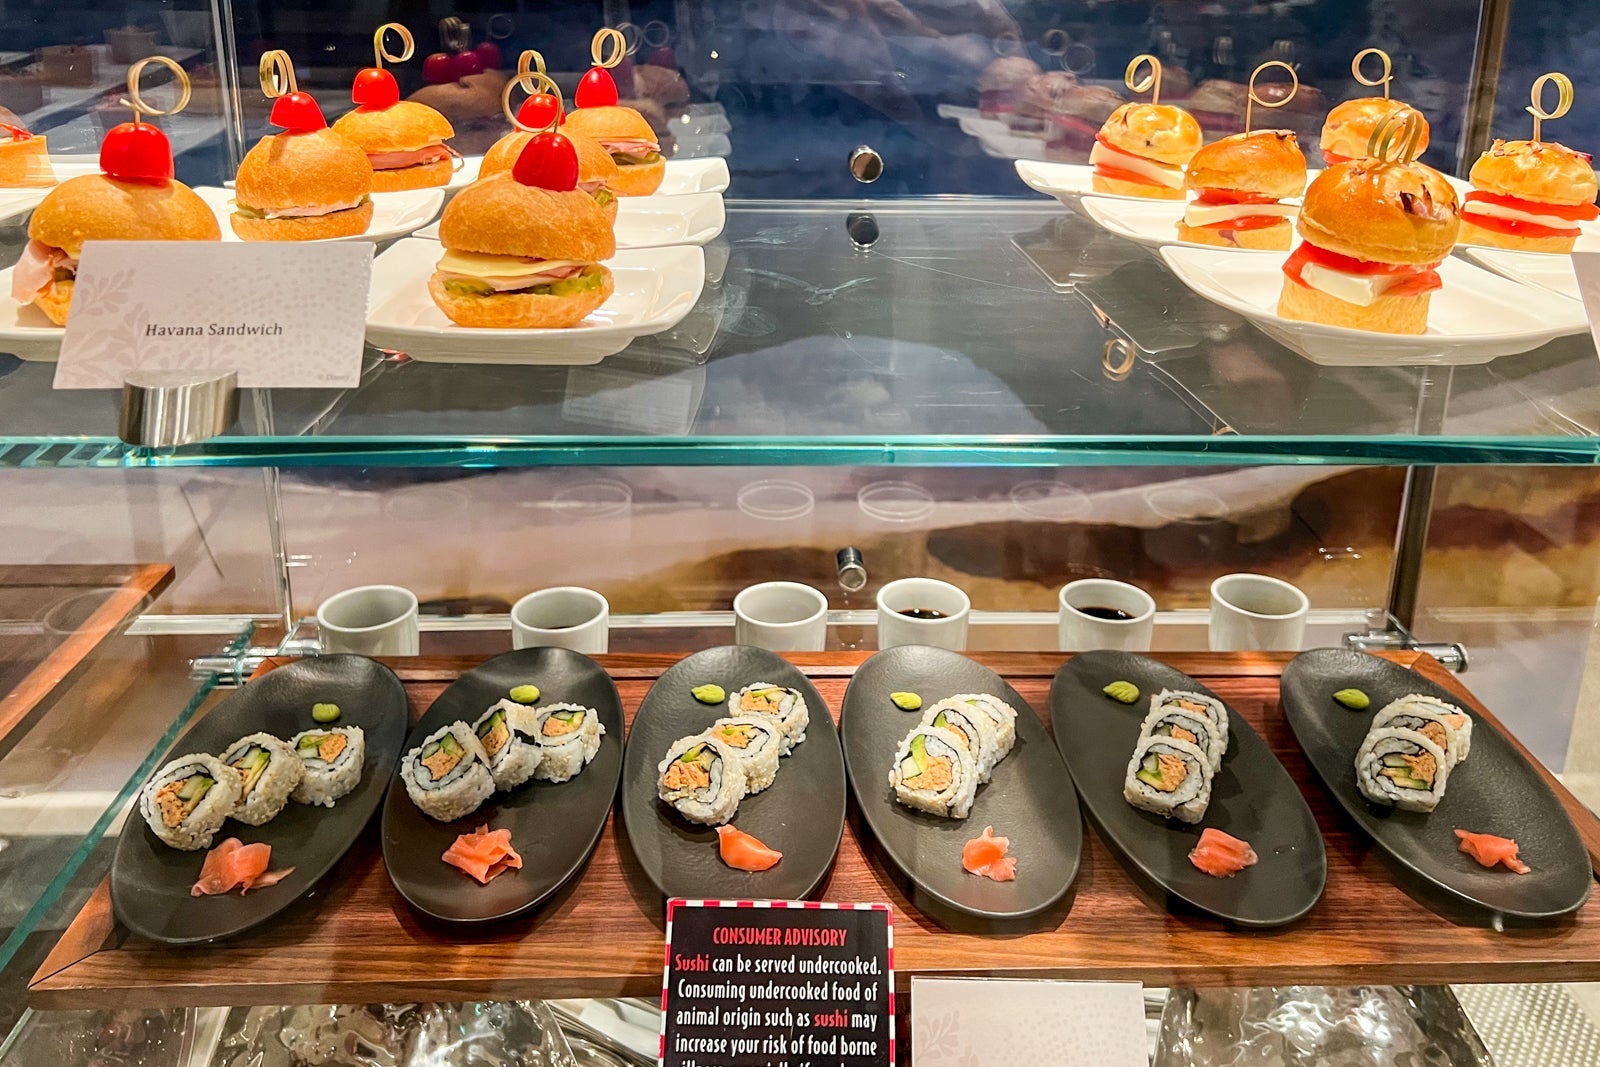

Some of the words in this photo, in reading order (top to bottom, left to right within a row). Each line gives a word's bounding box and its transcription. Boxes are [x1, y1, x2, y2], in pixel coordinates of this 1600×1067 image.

[146, 324, 203, 336] Havana
[208, 323, 283, 336] Sandwich
[325, 373, 350, 382] Diy
[713, 927, 782, 945] CONSUMER
[784, 928, 847, 946] ADVISORY
[675, 953, 710, 971] Sushi
[712, 959, 733, 972] can
[737, 953, 752, 972] be
[754, 955, 796, 974] served
[800, 955, 881, 975] undercooked.
[678, 978, 746, 1002] Consuming
[749, 980, 828, 1000] undercooked
[832, 981, 860, 1001] food
[864, 982, 878, 1001] of
[676, 1006, 719, 1025] animal
[723, 1007, 760, 1030] origin
[764, 1007, 793, 1026] such
[796, 1012, 810, 1027] as
[814, 1009, 848, 1027] sushi
[851, 1014, 877, 1032] may
[675, 1033, 728, 1053] increase
[731, 1039, 760, 1057] your
[763, 1034, 787, 1054] risk
[791, 1034, 804, 1054] of
[808, 1034, 837, 1055] food
[841, 1035, 877, 1056] borne
